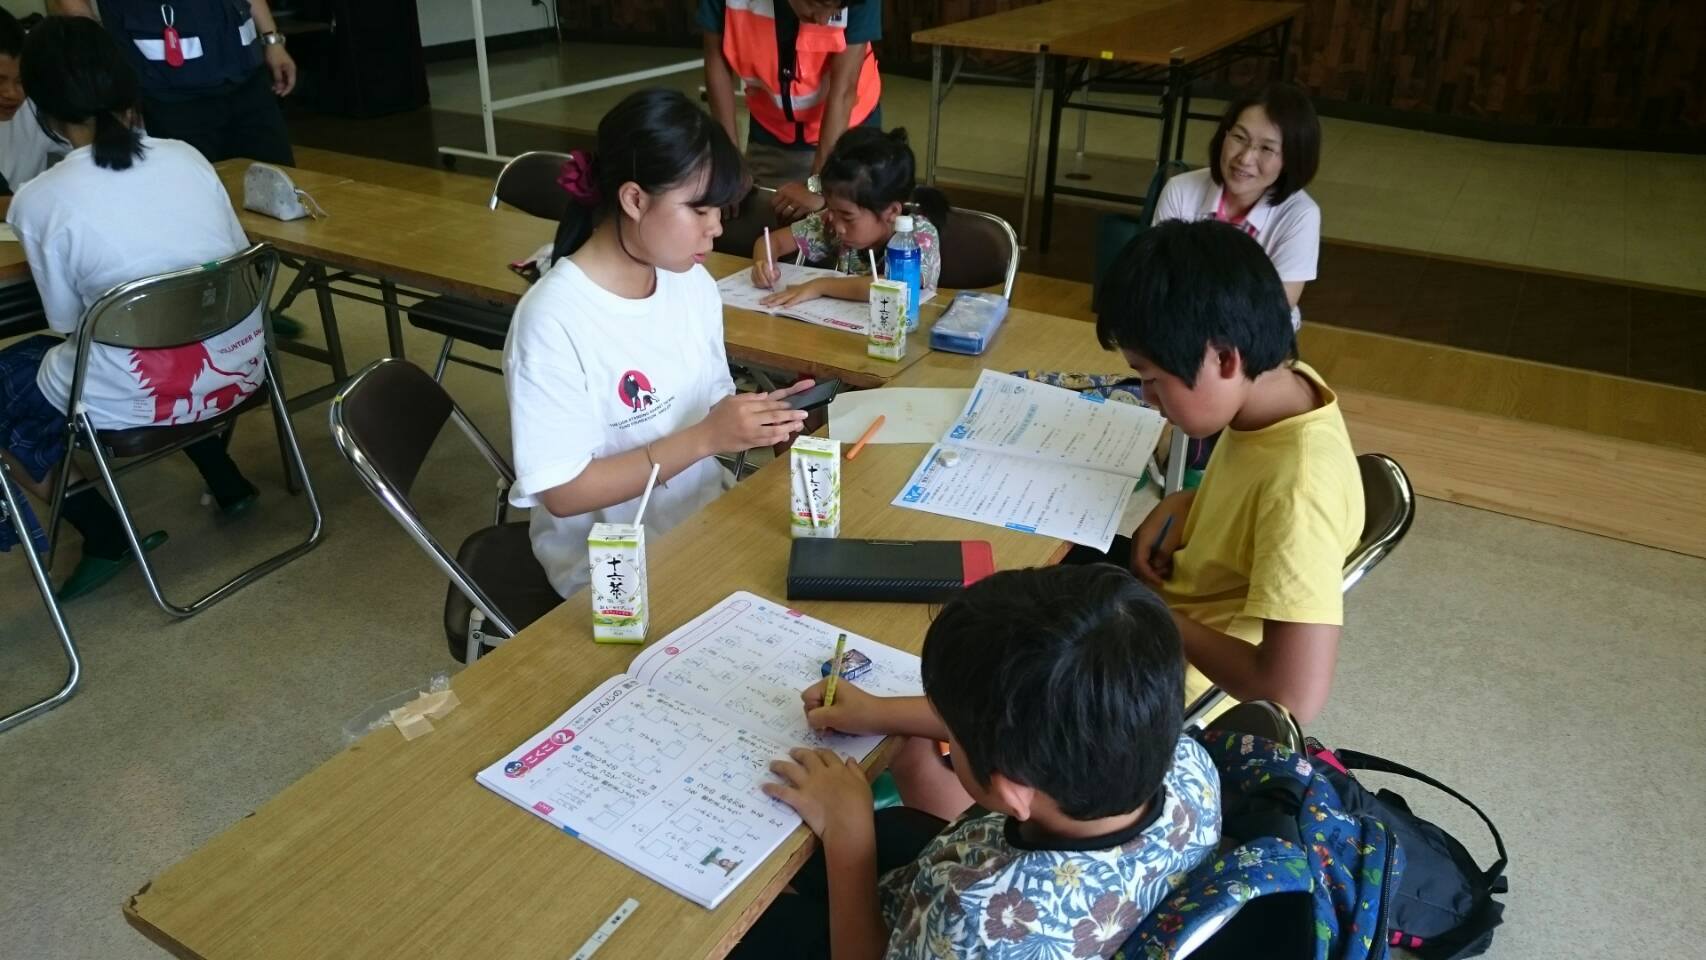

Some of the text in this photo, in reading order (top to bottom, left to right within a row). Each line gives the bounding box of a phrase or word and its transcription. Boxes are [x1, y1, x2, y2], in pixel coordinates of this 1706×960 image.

[879, 298, 891, 329] 十六茶
[217, 334, 253, 354] VOLUNTEER
[606, 557, 627, 600] 十六茶
[555, 731, 573, 743] 2
